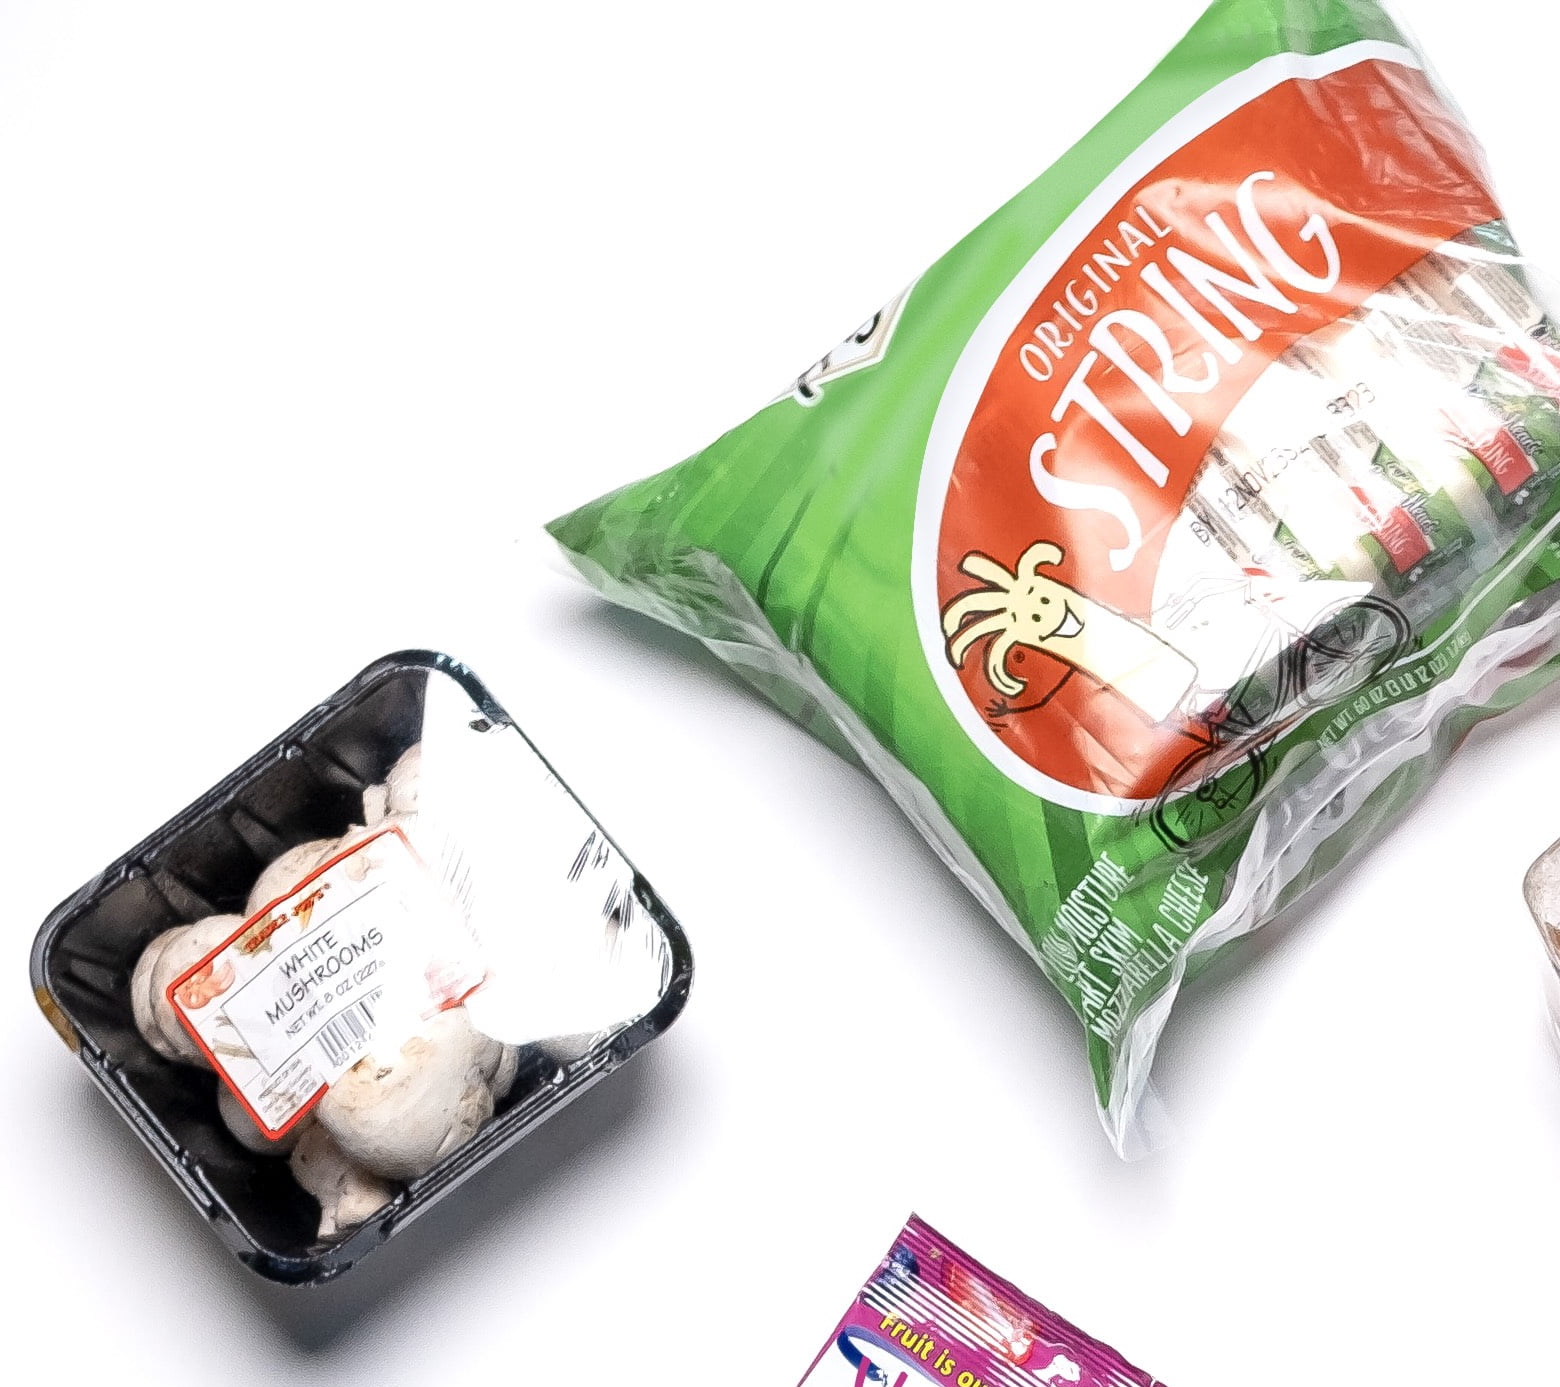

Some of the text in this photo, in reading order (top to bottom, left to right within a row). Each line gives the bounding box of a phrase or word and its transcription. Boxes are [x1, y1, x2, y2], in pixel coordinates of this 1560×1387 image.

[1019, 205, 1172, 381] ORIGINAL
[1029, 170, 1341, 571] STRING
[1055, 851, 1135, 953] MOISTURE
[1159, 857, 1209, 934] CHEESE
[265, 928, 384, 1024] MUSHROOMS
[280, 930, 338, 979] WHITE
[1090, 917, 1144, 976] SKIM
[879, 1312, 935, 1361] Fruit
